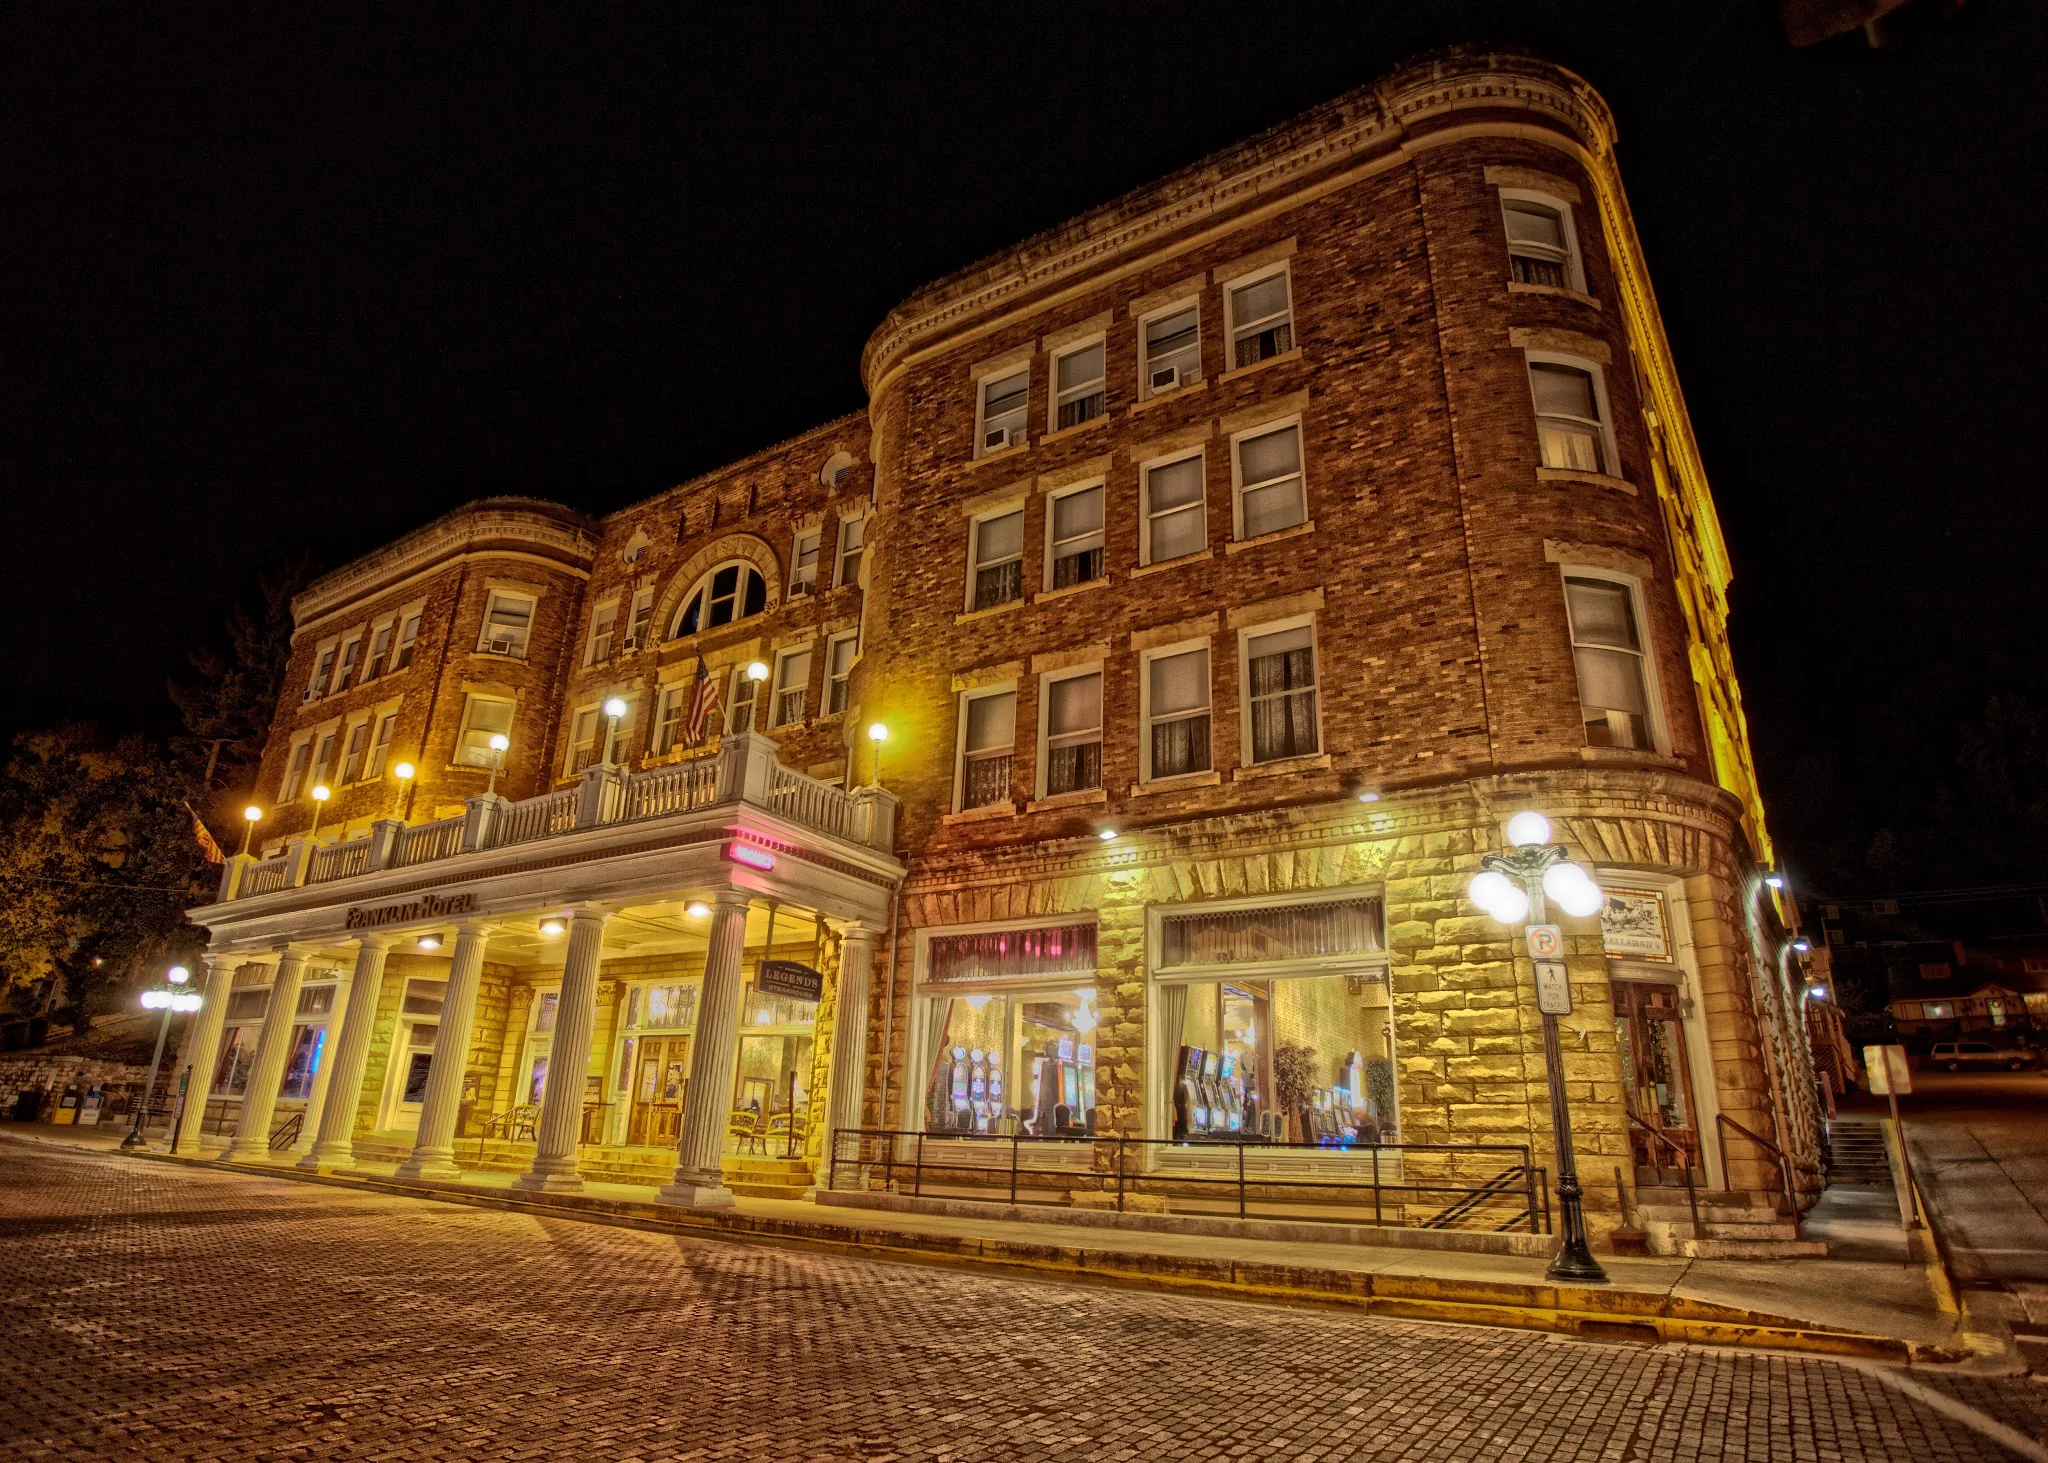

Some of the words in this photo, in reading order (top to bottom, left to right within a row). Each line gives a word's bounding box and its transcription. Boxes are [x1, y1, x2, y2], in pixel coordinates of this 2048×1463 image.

[346, 903, 418, 929] FRANKLIN
[421, 893, 474, 919] HOTEL
[765, 968, 818, 989] LEGENDS
[768, 984, 813, 998] STEAKHOUSE
[1547, 992, 1560, 1000] FOR
[1542, 1001, 1568, 1010] TRAFFIC
